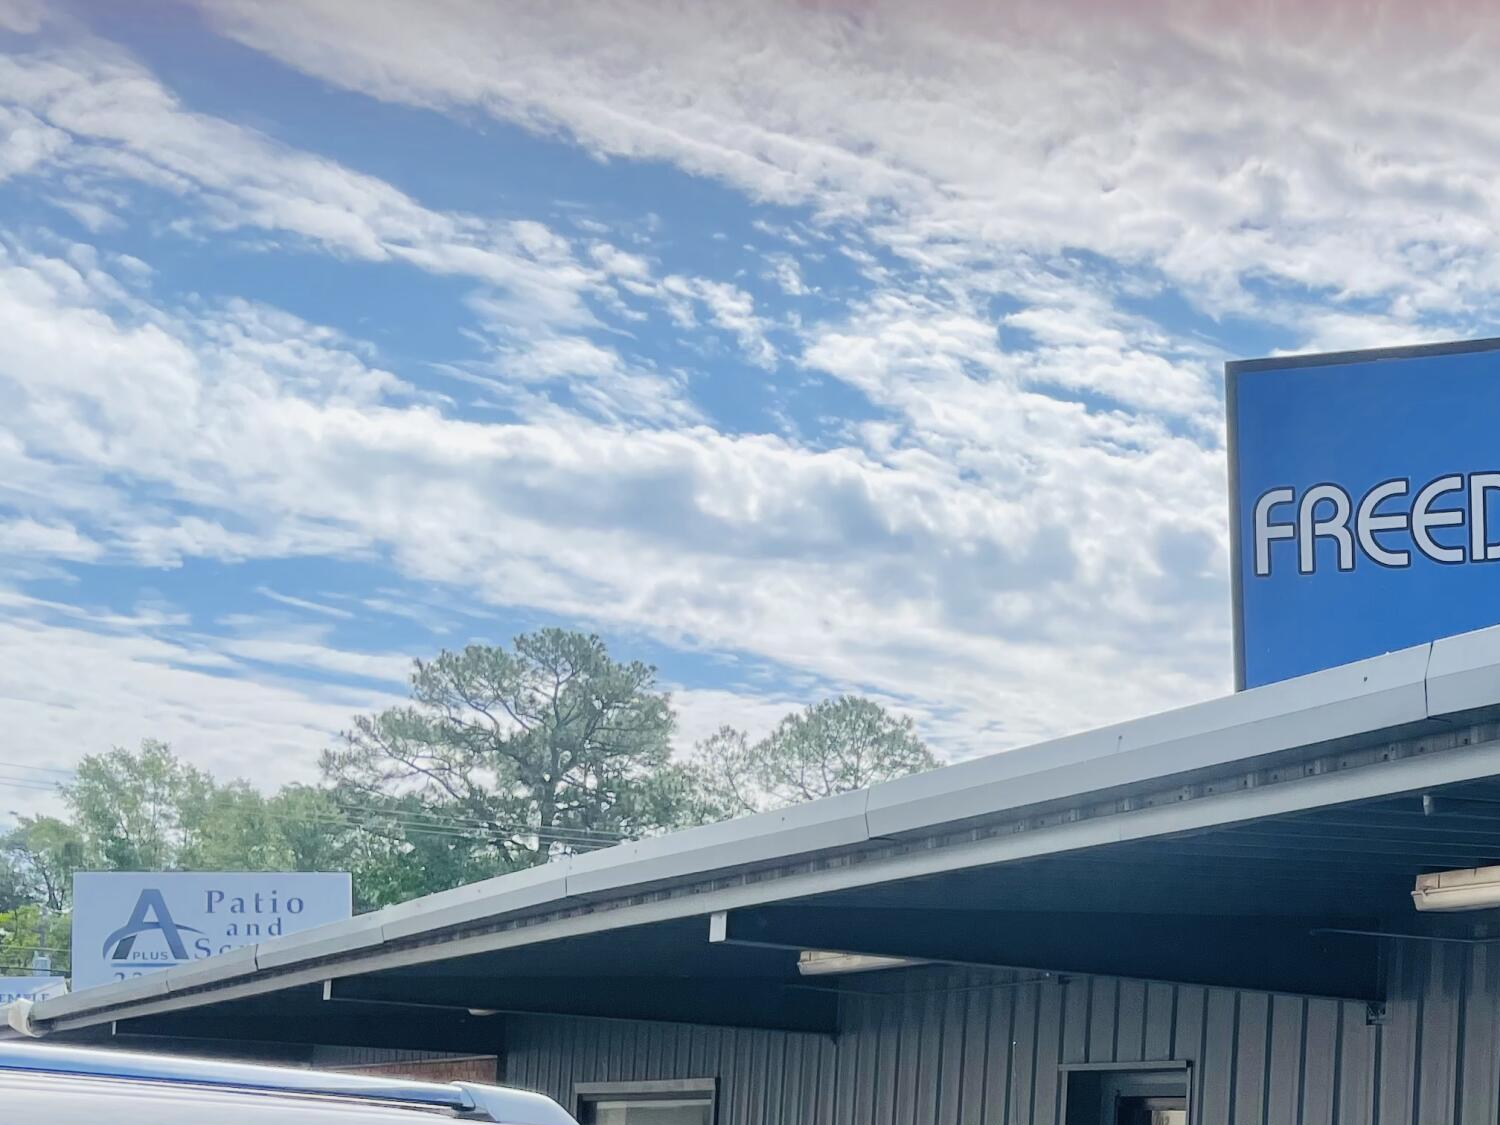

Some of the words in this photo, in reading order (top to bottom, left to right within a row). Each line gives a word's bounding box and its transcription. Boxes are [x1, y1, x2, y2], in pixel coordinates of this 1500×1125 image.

[204, 889, 304, 914] Patio
[226, 917, 282, 936] and
[132, 951, 169, 961] PLUS
